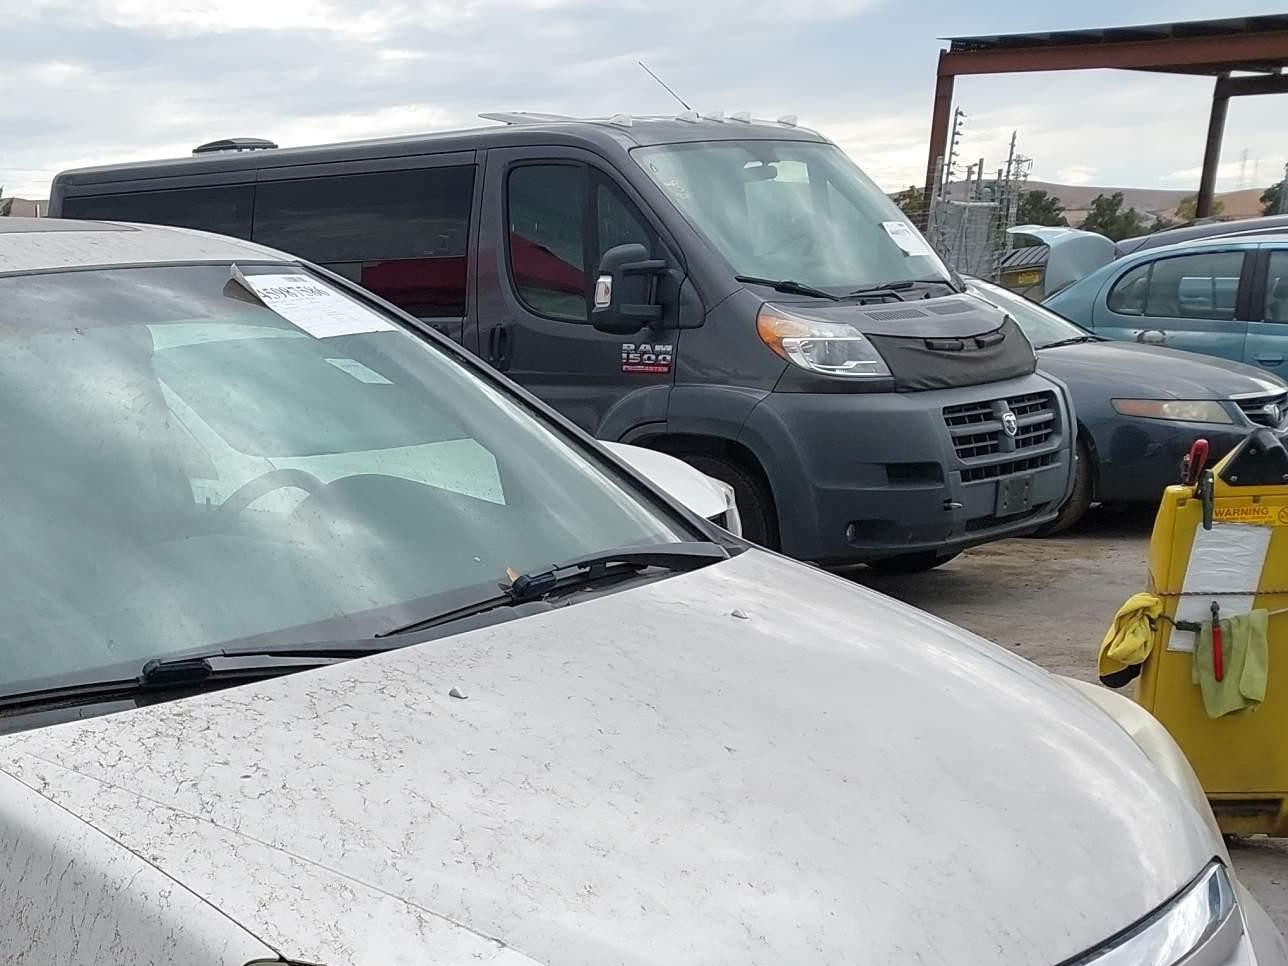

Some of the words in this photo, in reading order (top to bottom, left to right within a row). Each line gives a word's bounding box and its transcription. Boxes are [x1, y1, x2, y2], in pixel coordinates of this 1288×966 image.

[622, 343, 673, 353] RAM
[622, 353, 672, 364] 1500
[1215, 506, 1269, 518] WARNING
